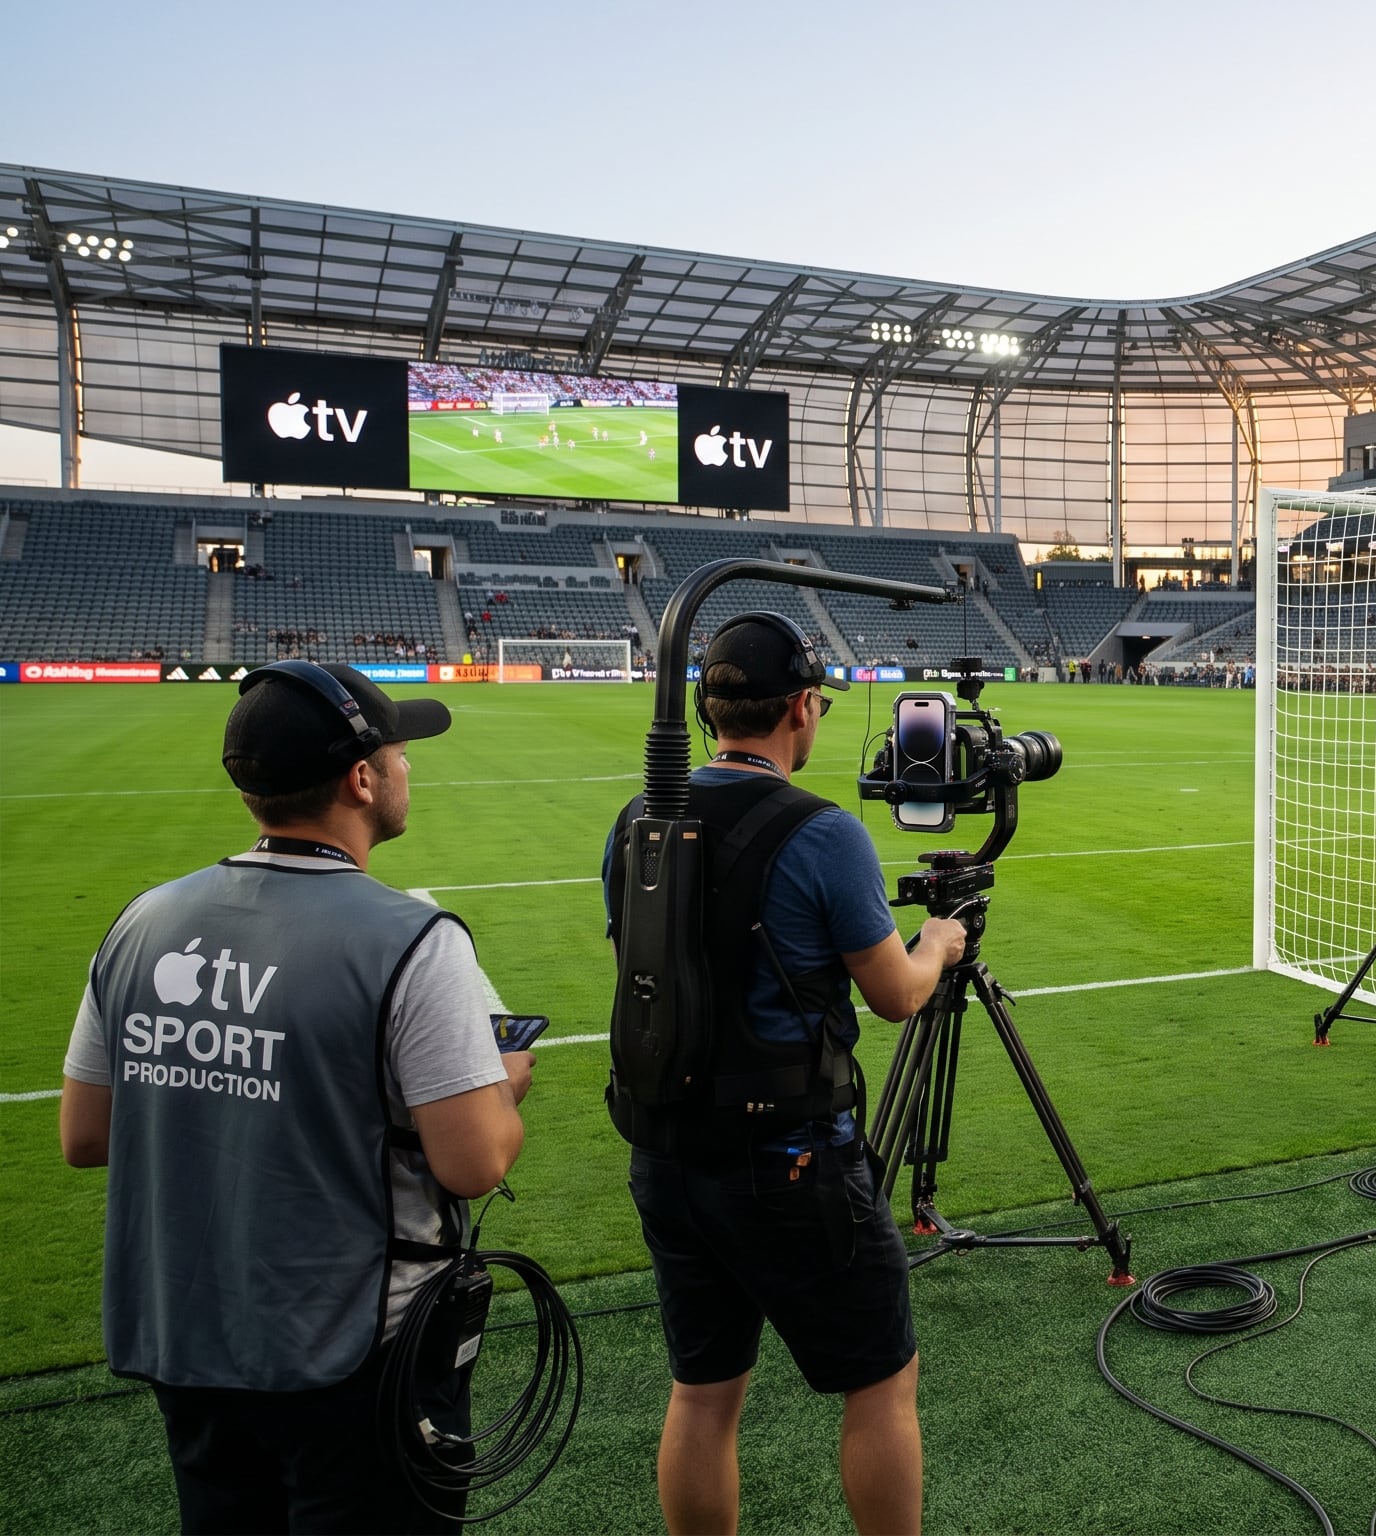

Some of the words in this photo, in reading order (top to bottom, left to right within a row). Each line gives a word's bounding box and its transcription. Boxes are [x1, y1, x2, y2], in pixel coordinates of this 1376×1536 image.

[312, 399, 368, 443] tv
[728, 431, 773, 469] tv
[211, 948, 279, 1014] tv
[123, 1012, 286, 1071] SPORT
[124, 1061, 281, 1102] PRODUCTION
